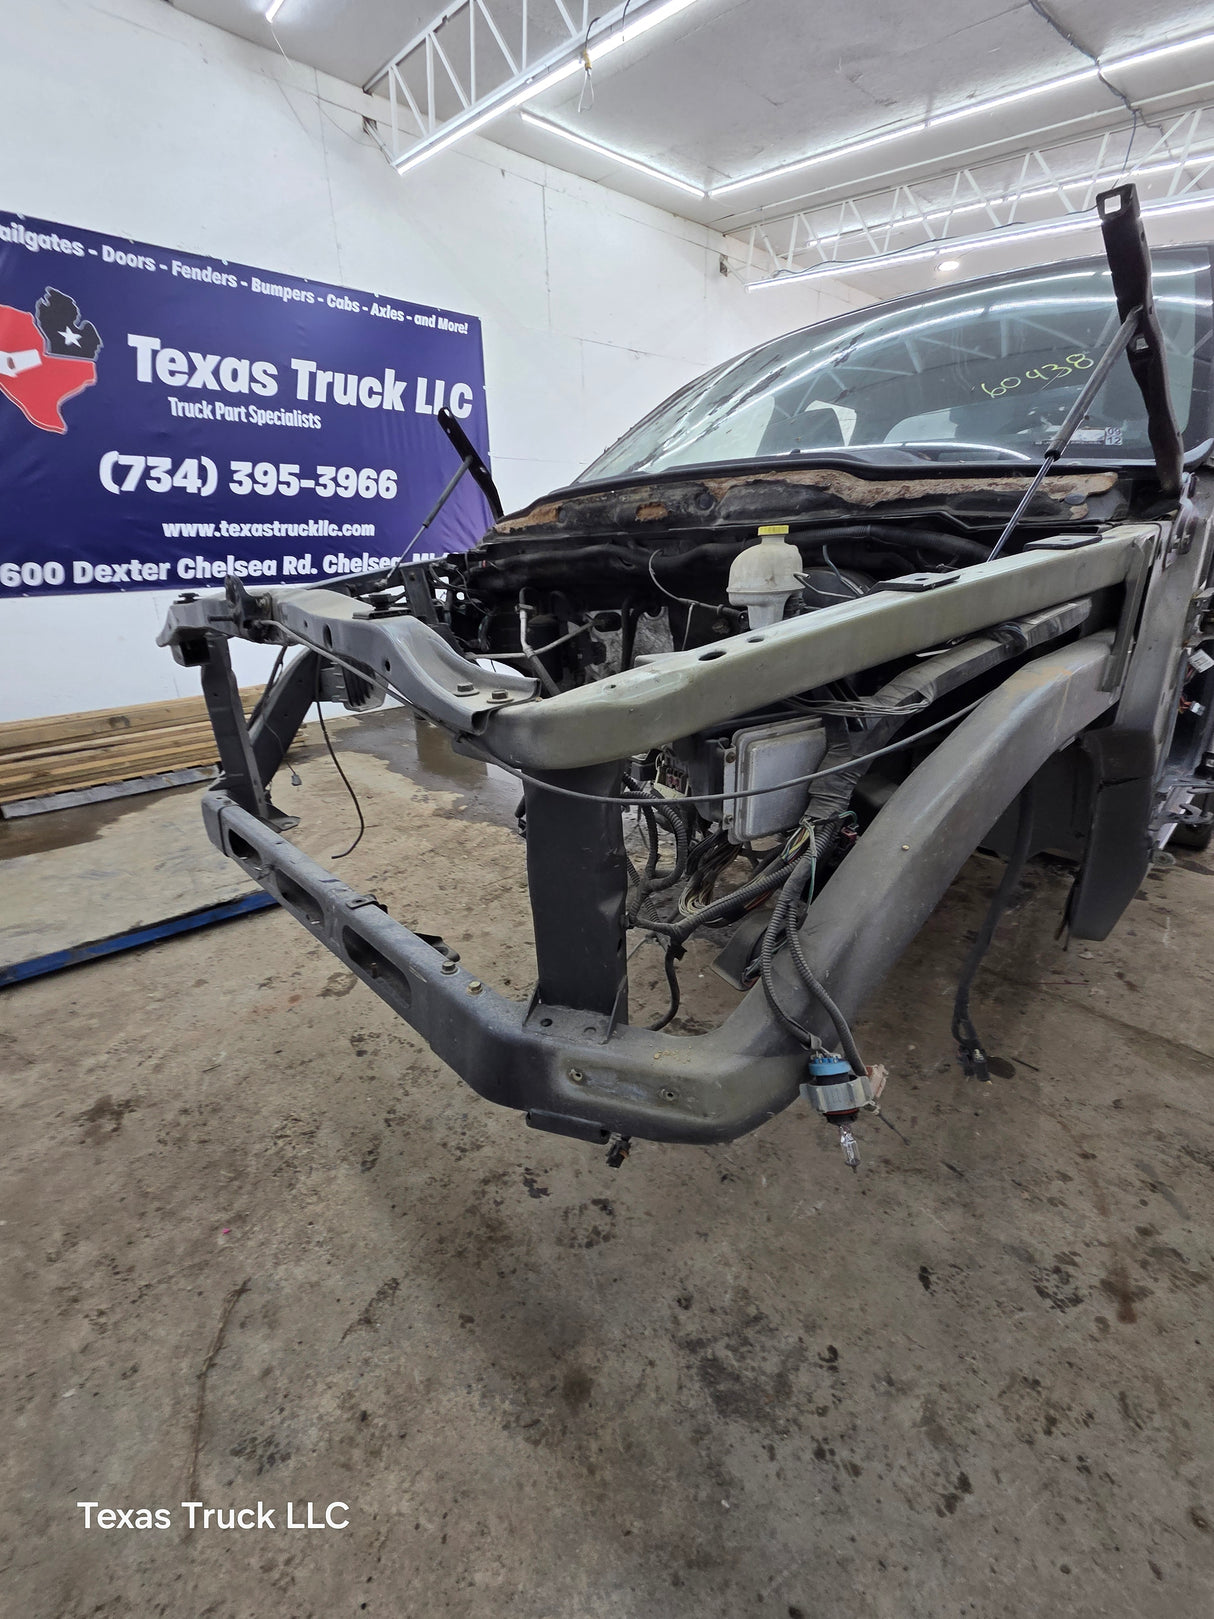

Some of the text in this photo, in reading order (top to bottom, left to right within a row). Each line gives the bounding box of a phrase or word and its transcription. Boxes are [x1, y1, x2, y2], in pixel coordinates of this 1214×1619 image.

[0, 222, 85, 257] ailgates
[102, 245, 156, 272] Doors
[171, 260, 237, 288] Fenders
[251, 277, 314, 303] Bumpers
[326, 293, 360, 313] Cabs
[370, 302, 404, 322] Axles
[414, 314, 436, 328] and
[437, 316, 469, 335] More!
[127, 333, 474, 419] Texas Truck LLC
[167, 396, 322, 430] Truck Part Specialists
[99, 450, 398, 500] (734) 395-3966
[161, 519, 375, 538] www.texastruckllc.com
[0, 561, 65, 587] 600
[73, 559, 171, 584] Dexter
[177, 555, 277, 579] Chelsea
[282, 553, 318, 575] Rd.
